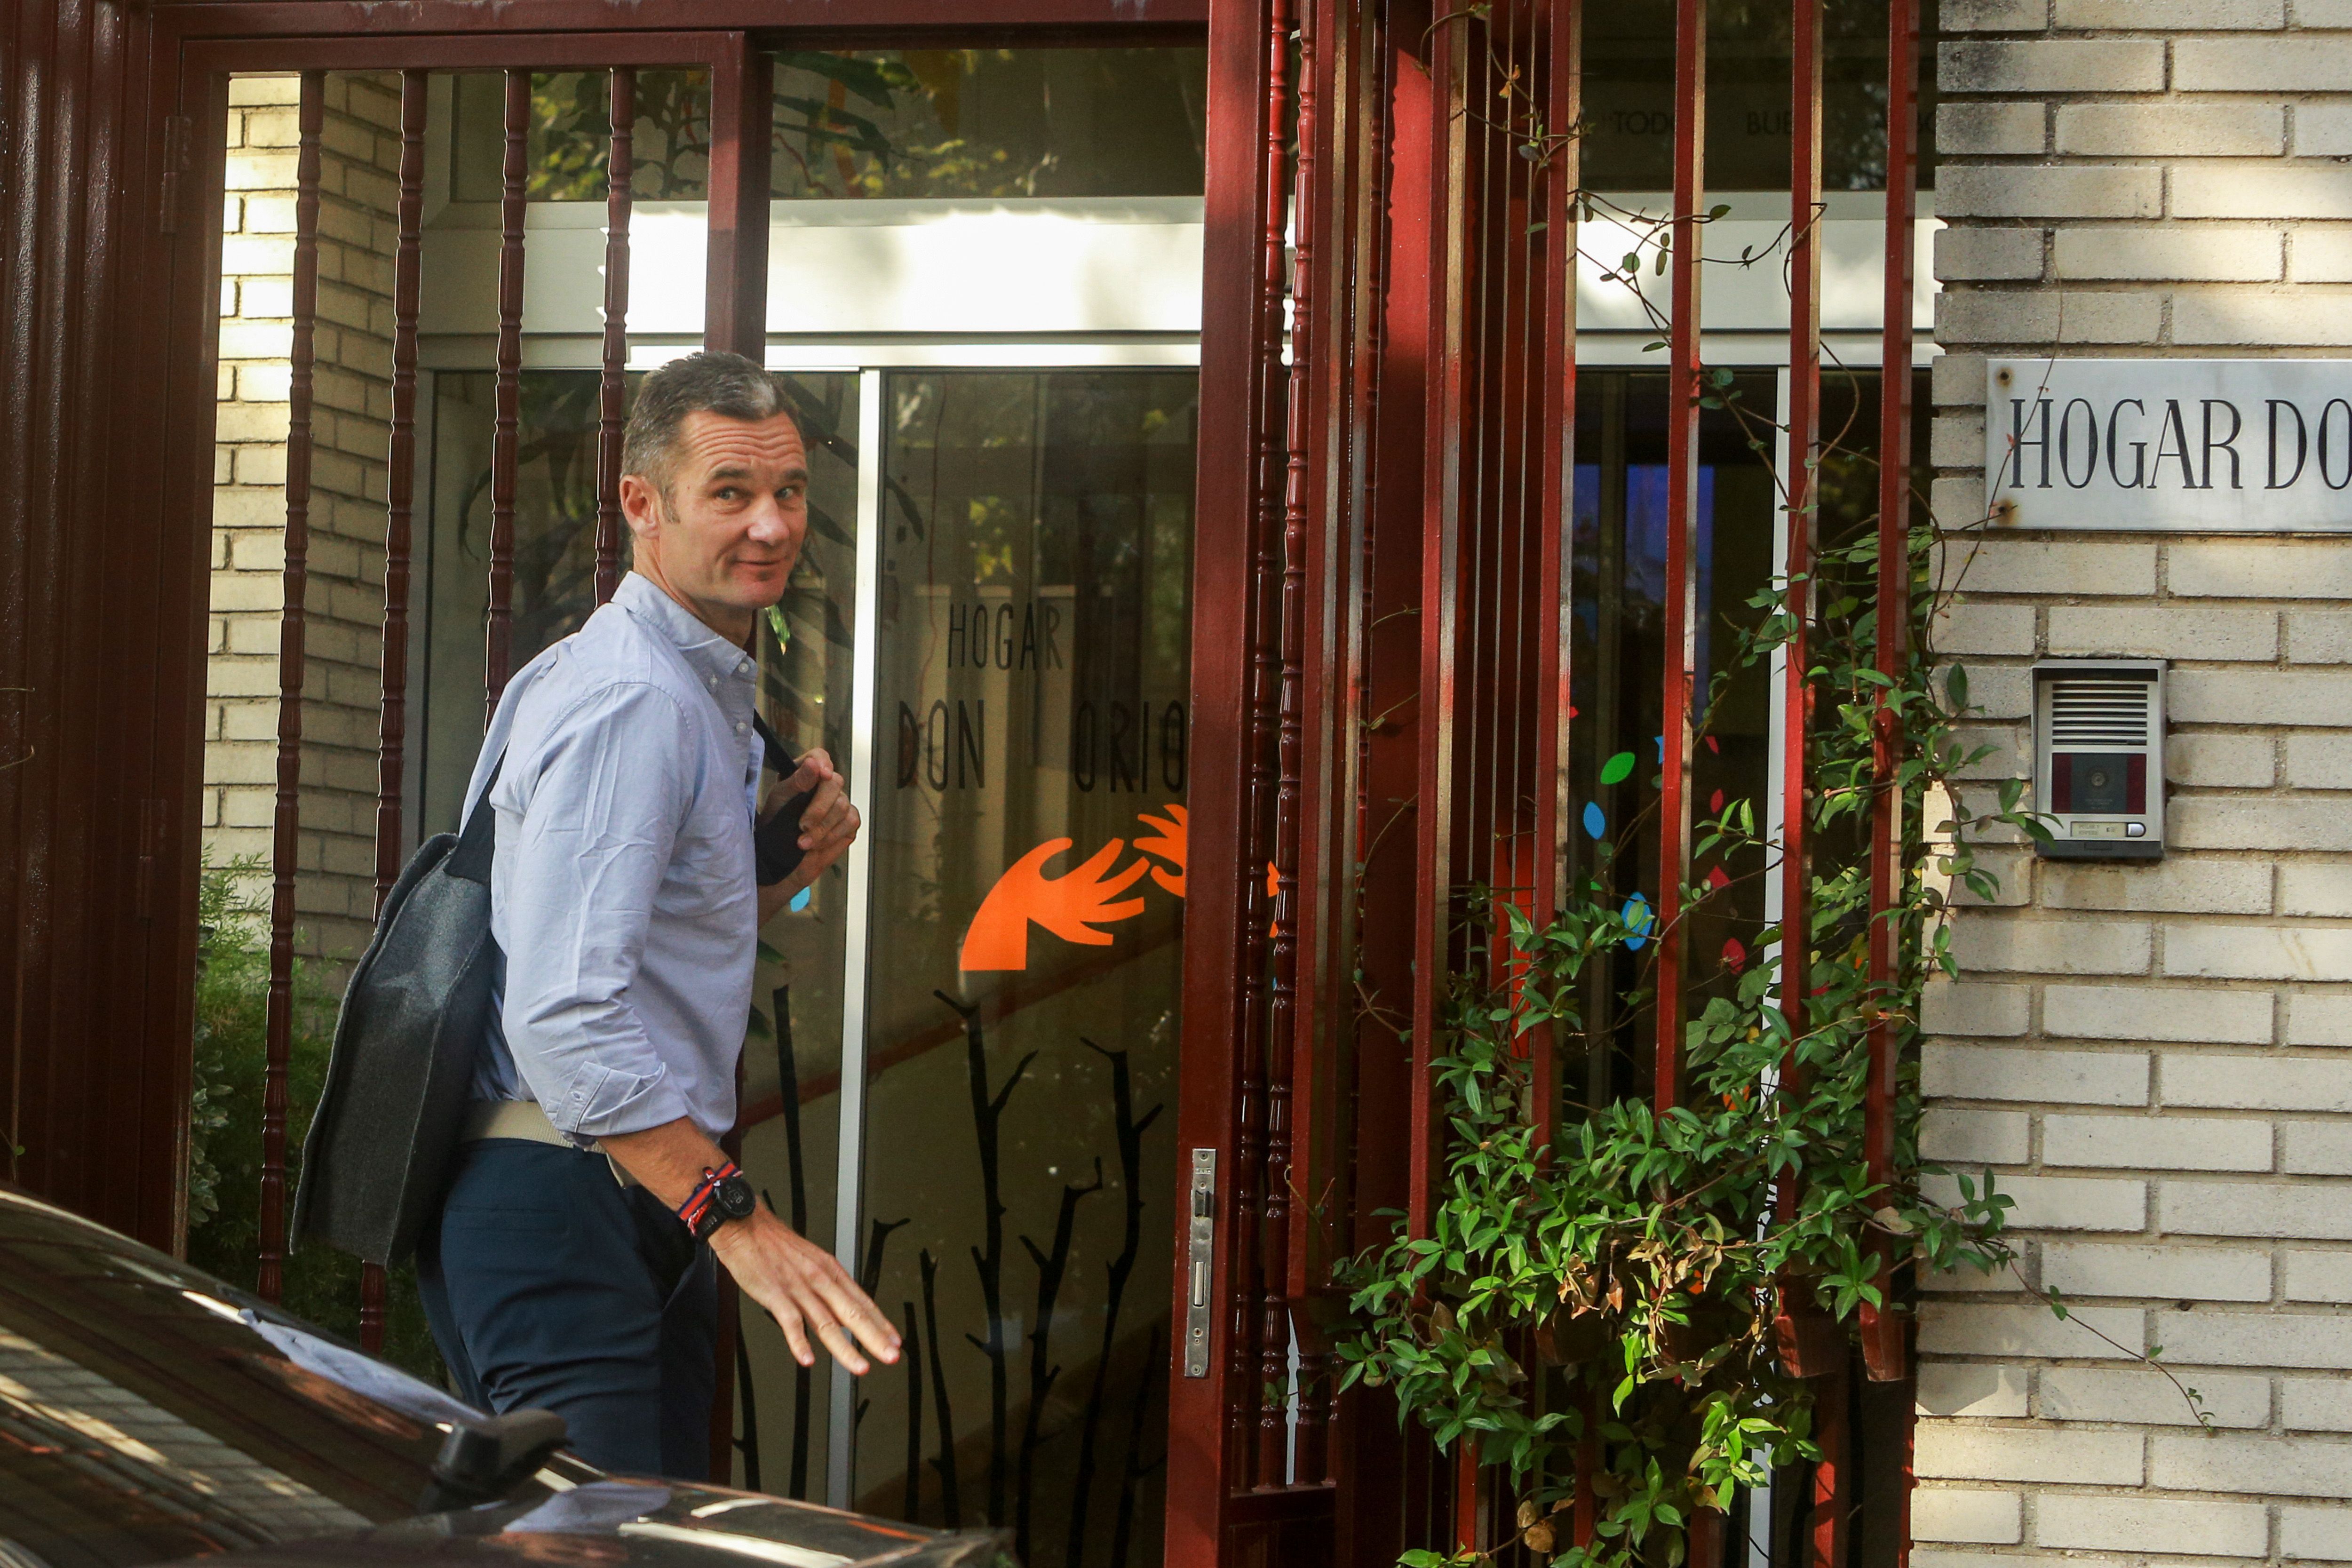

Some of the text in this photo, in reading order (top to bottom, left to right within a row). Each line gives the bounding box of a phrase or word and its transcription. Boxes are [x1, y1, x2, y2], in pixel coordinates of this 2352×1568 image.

[2009, 398, 2352, 490] HOGAR DO
[948, 603, 1063, 670] HOGAR
[897, 700, 1186, 793] DON ORIO
